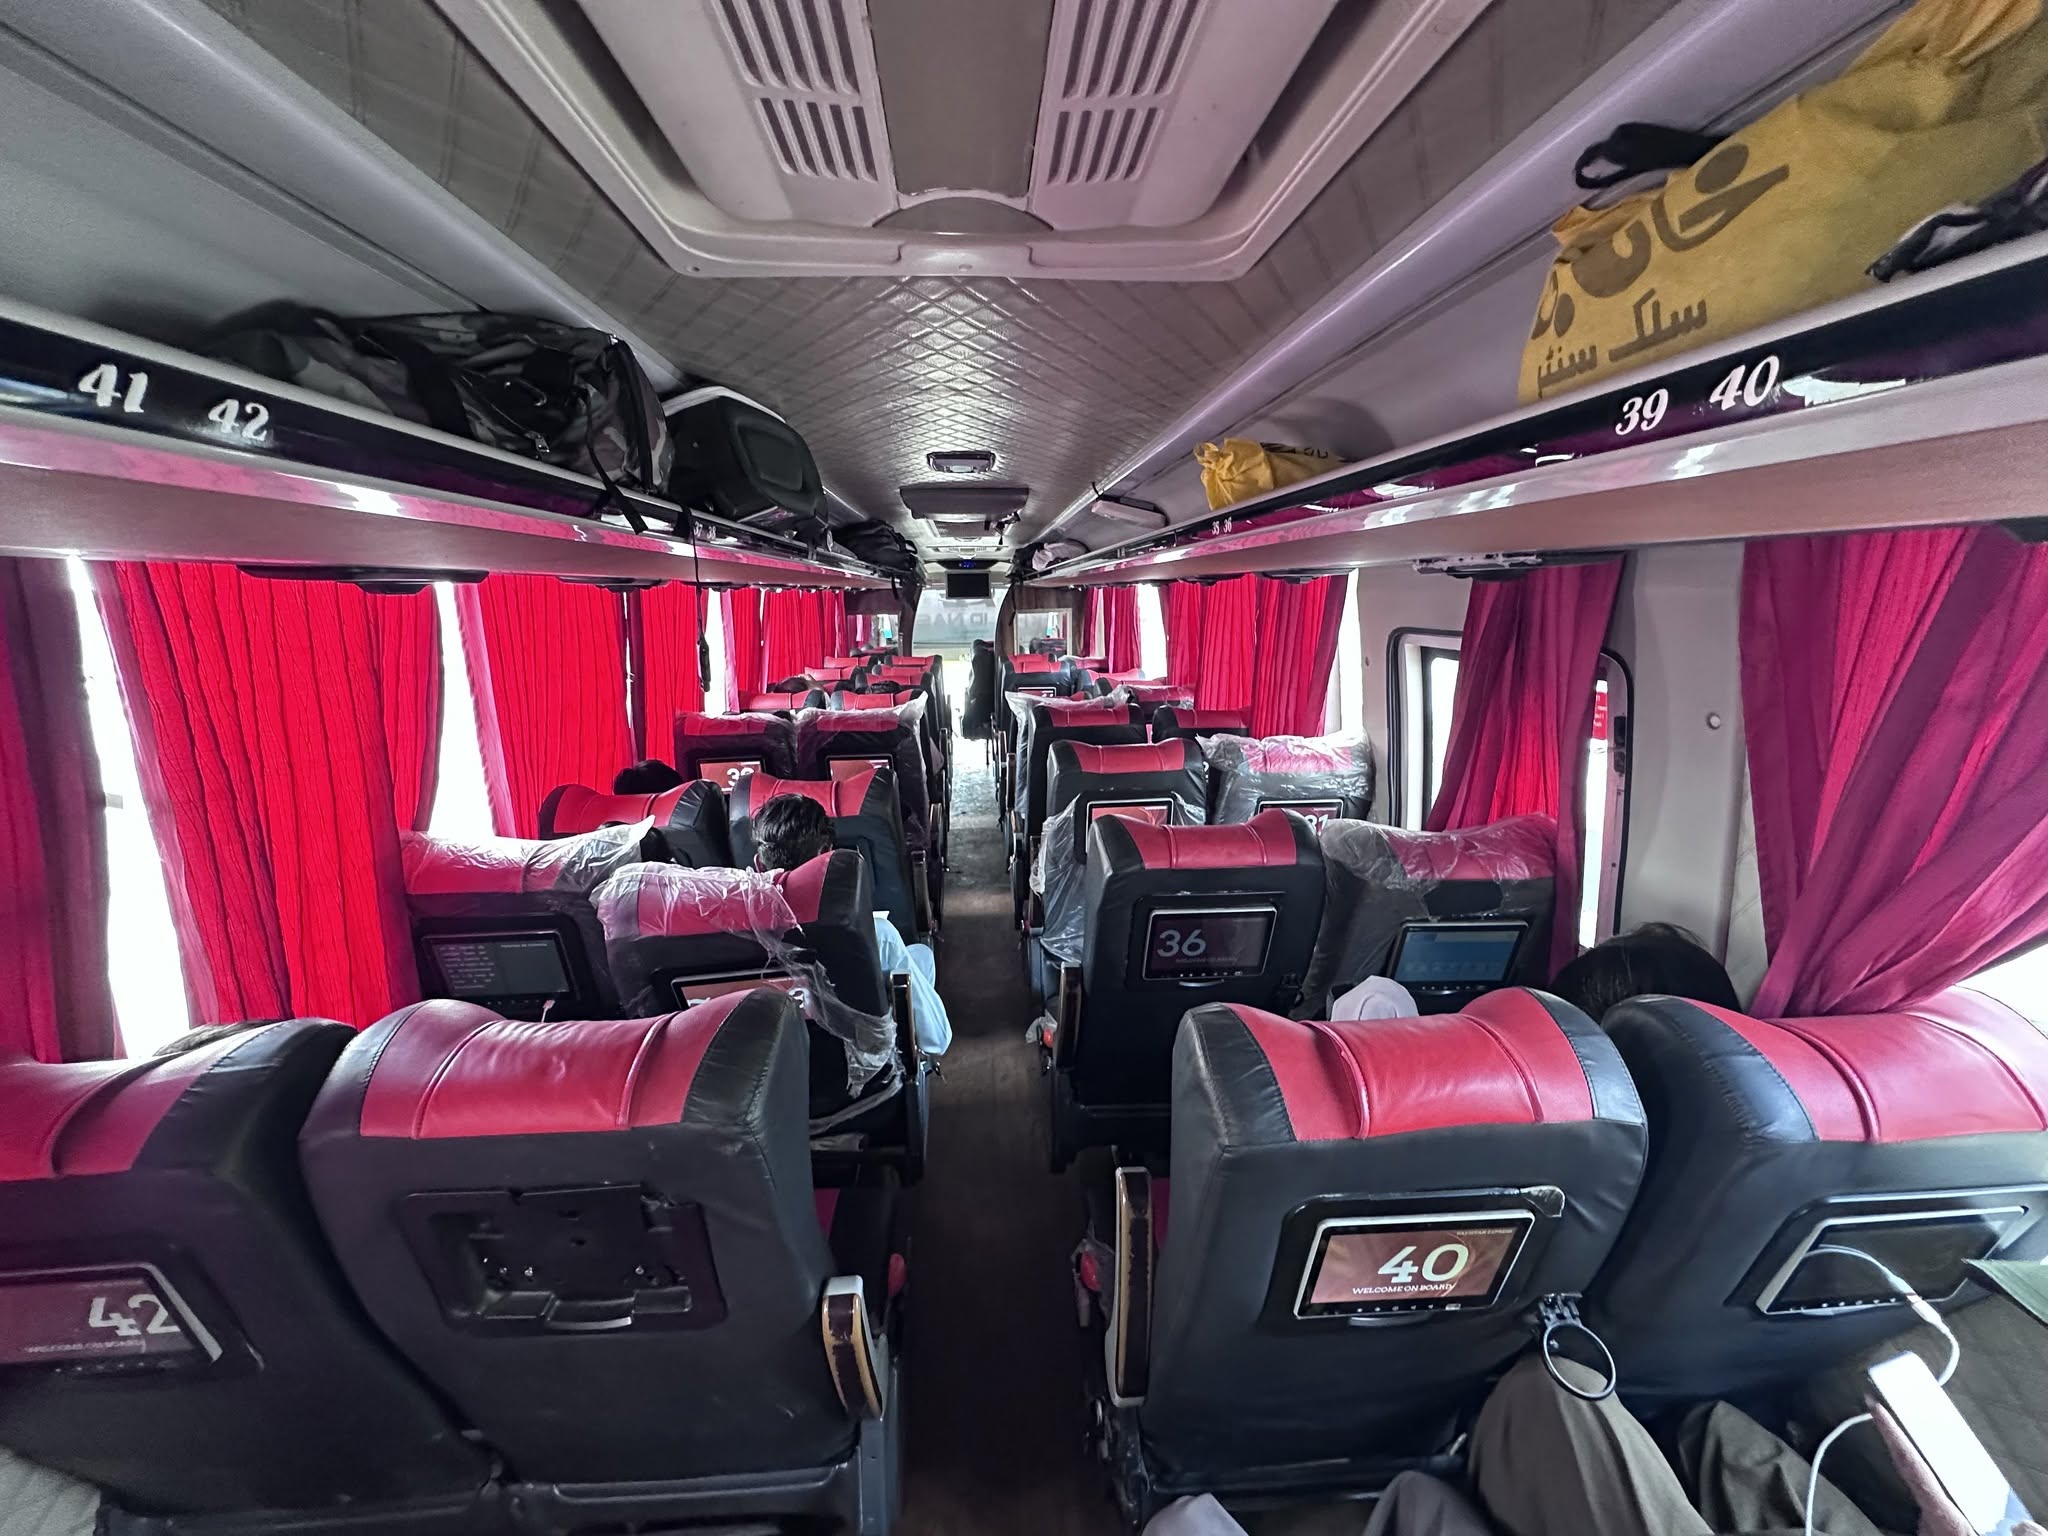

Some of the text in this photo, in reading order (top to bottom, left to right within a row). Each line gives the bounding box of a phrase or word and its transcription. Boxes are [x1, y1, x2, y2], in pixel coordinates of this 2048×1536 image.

[78, 364, 270, 441] 41 42
[1615, 355, 1781, 436] 39 40
[1157, 929, 1206, 957] 36
[1378, 1243, 1469, 1283] 40
[1352, 1282, 1454, 1295] WELCOME ON BOARD
[88, 1294, 181, 1336] 42
